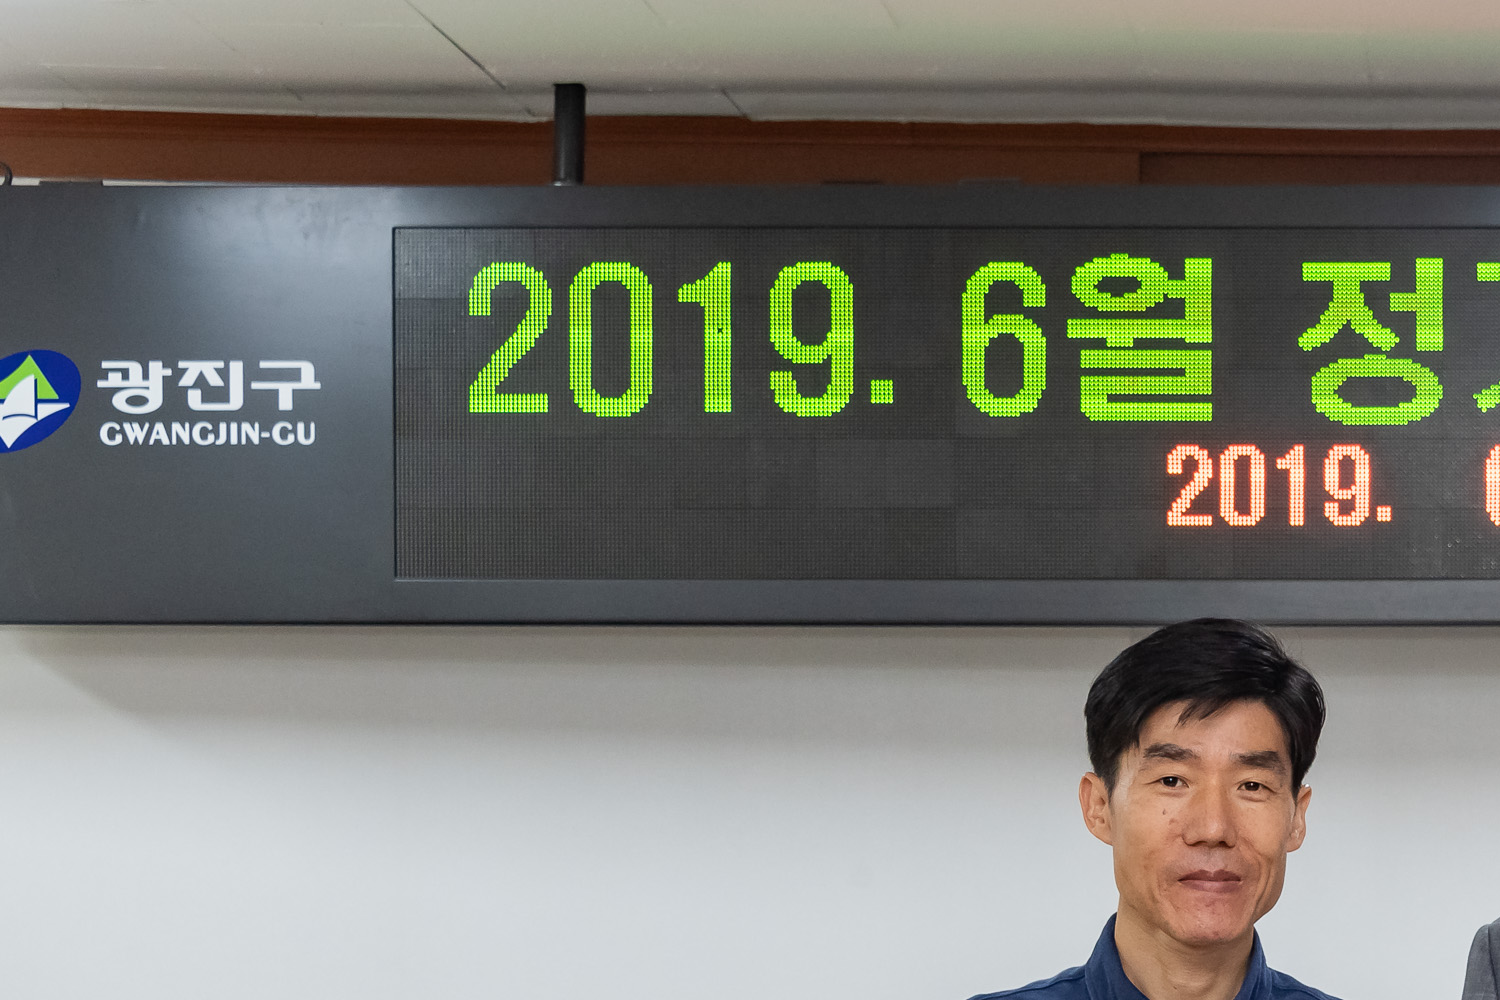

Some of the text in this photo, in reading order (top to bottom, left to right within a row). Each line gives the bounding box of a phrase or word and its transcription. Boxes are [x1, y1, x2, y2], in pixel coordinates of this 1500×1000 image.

[469, 261, 894, 418] 2019.
[962, 254, 1213, 422] 6월
[97, 360, 321, 414] 광진구
[99, 421, 316, 446] GWANGJIN-GU
[1166, 444, 1393, 527] 2019.
